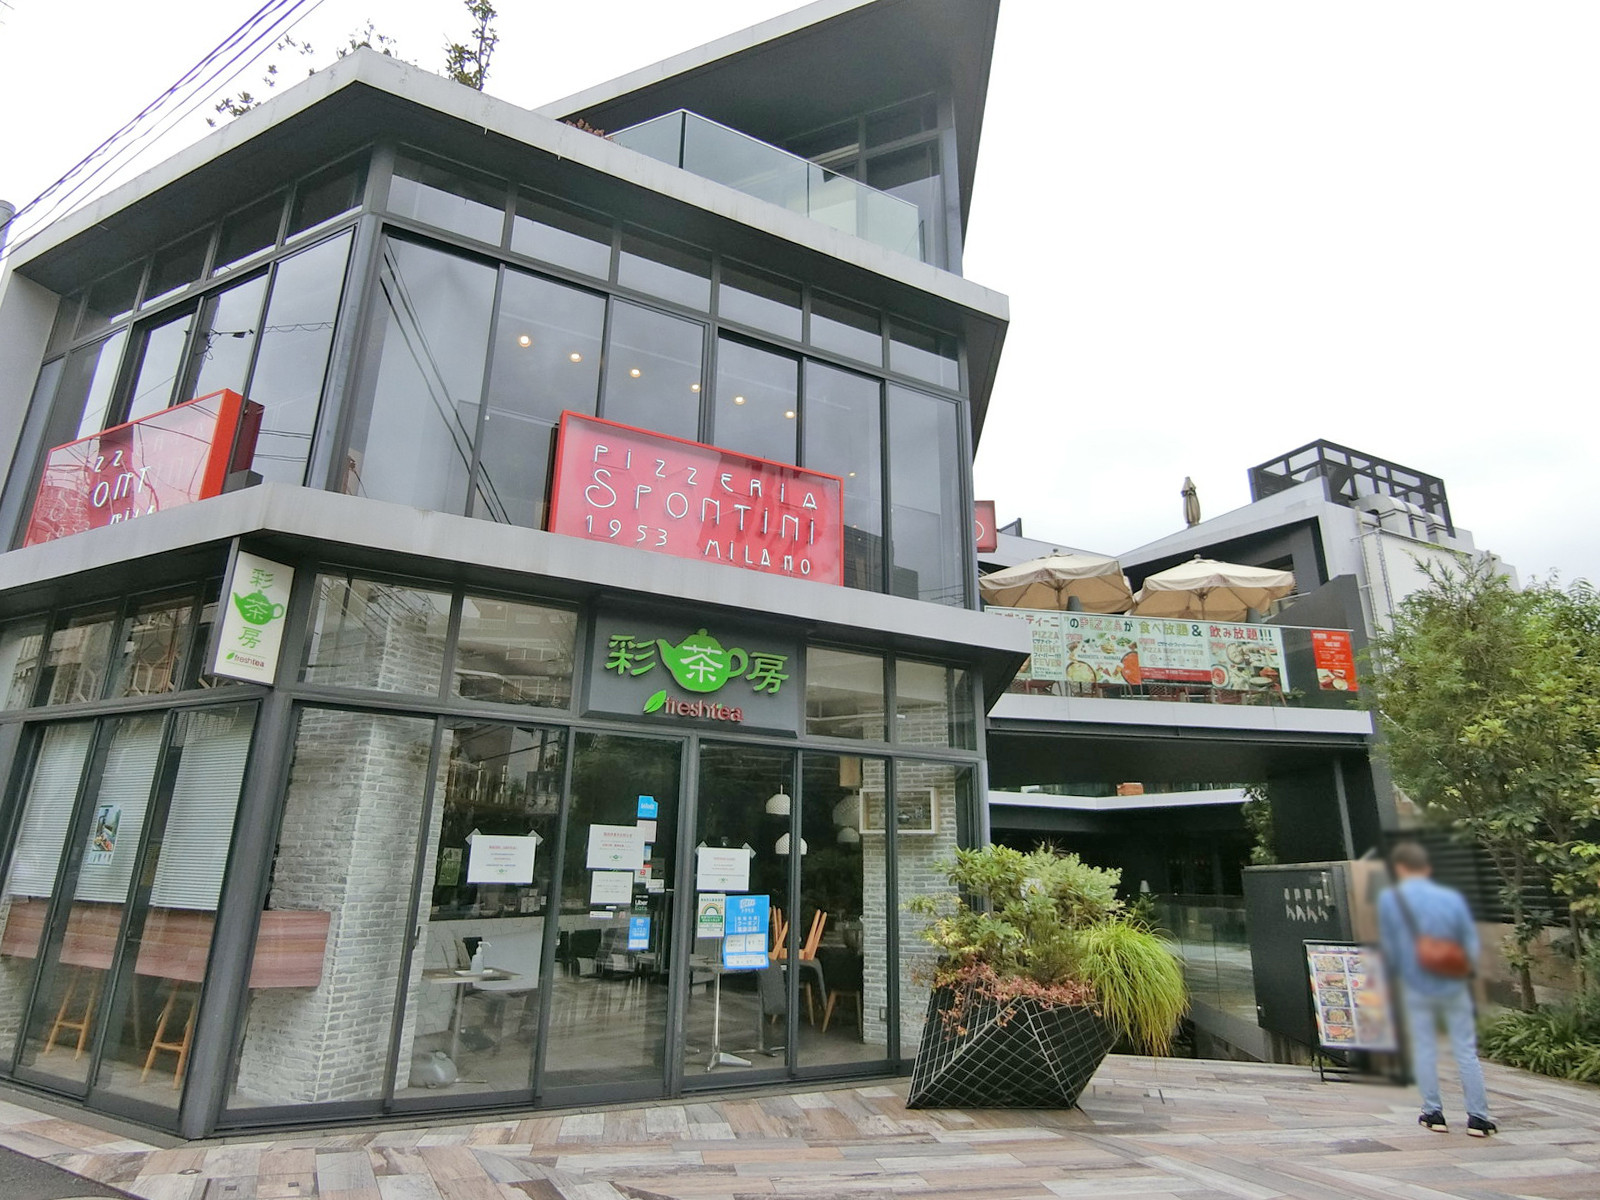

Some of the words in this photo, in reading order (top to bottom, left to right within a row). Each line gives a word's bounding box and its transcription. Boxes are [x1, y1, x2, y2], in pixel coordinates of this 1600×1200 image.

[585, 469, 815, 545] SPONTINI
[594, 444, 818, 510] PIZZERIA
[585, 514, 668, 546] 1953
[704, 539, 811, 575] MILANO
[234, 653, 265, 668] freshtea
[604, 634, 790, 694] 彩茶房
[1032, 630, 1060, 640] PIZZA
[665, 696, 744, 721] freshtea
